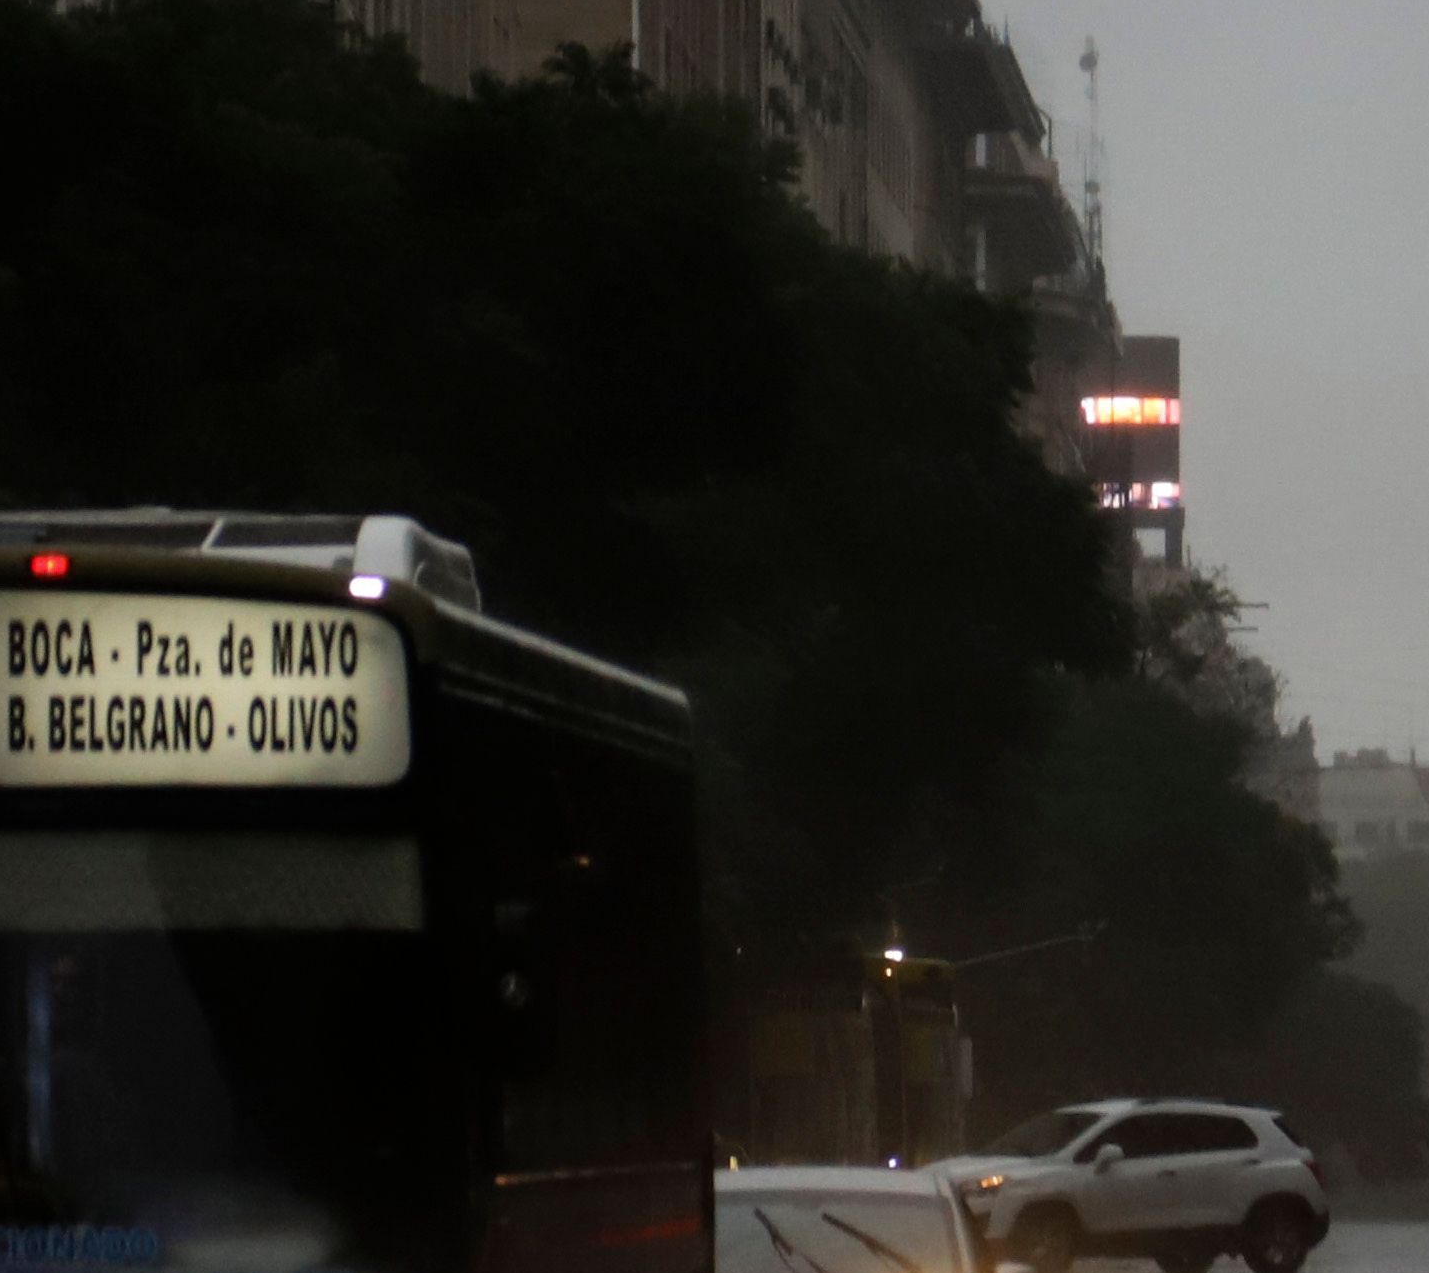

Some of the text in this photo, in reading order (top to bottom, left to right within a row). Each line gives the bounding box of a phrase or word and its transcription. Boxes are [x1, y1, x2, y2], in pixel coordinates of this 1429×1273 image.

[9, 621, 94, 676] BOCA
[137, 622, 200, 677] Pza.
[219, 623, 253, 676] de
[272, 621, 358, 677] MAYO
[9, 697, 35, 751] B.
[49, 697, 215, 752] BELGRANO
[249, 698, 359, 752] OLIVOS
